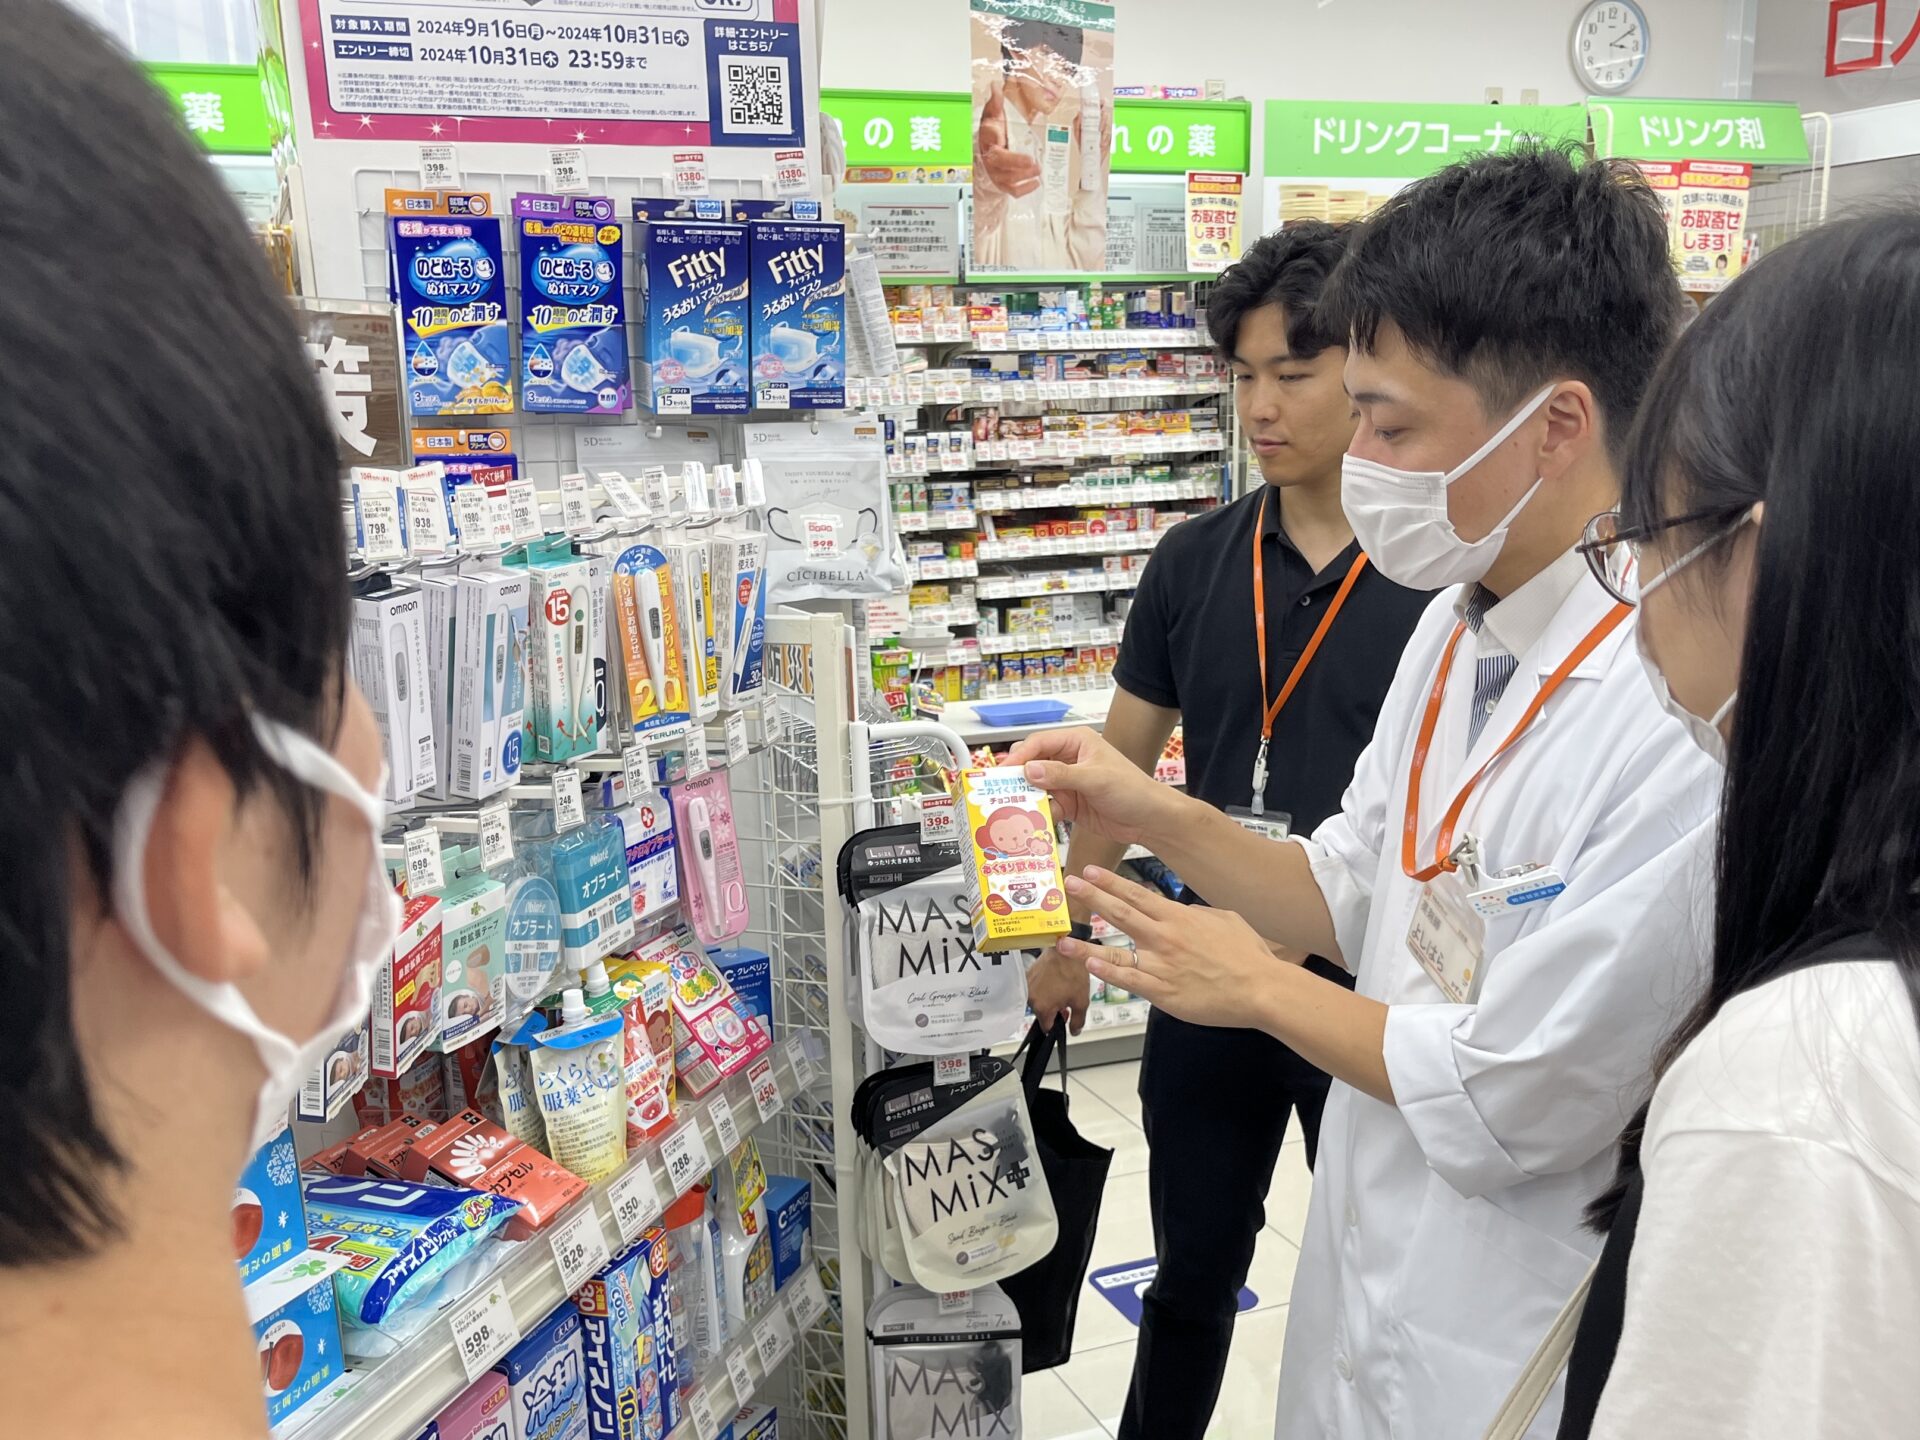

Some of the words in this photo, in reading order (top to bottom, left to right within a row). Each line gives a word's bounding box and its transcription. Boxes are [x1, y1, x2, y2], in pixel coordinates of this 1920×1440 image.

[1597, 11, 1605, 23] 11
[1608, 7, 1617, 19] 12
[1623, 12, 1627, 24] 1
[1588, 23, 1598, 35] 10
[1584, 40, 1591, 51] 9
[1632, 40, 1639, 52] 3
[568, 50, 648, 70] 23:59まで
[1587, 56, 1594, 67] 8
[1595, 67, 1601, 79] 7
[1606, 71, 1612, 81] 6
[1618, 68, 1625, 79] 5
[180, 91, 225, 133] 薬
[1636, 113, 1767, 151] ドリンク剤
[426, 163, 445, 172] 398
[556, 167, 574, 175] 398
[406, 199, 433, 209] 日本製
[533, 201, 559, 211] 日本製
[1191, 209, 1237, 225] お取寄せ
[1681, 209, 1741, 230] お取寄せ
[1683, 232, 1732, 252] します!
[668, 247, 726, 288] Fitty
[768, 244, 824, 284] Fitty
[426, 281, 480, 295] ぬれマスク
[546, 282, 600, 296] ぬれマスク
[427, 436, 453, 447] 日本製
[369, 523, 386, 534] 798
[415, 517, 431, 528] 938
[738, 558, 755, 571] 使える
[786, 571, 865, 582] CICIBELLA
[500, 583, 522, 597] OMRON
[390, 600, 418, 617] OMRON
[547, 595, 569, 623] 15
[648, 728, 685, 741] TERUMO
[629, 769, 641, 780] 318
[685, 777, 714, 791] OMRON
[559, 796, 572, 806] 248
[990, 795, 1027, 805] チョコ風味
[926, 815, 950, 827] 398
[486, 832, 500, 846] 698
[413, 858, 428, 871] 698
[581, 865, 622, 899] オブラート
[878, 894, 973, 936] MAS
[512, 919, 553, 936] オブラート
[736, 962, 769, 975] クレベリン
[940, 1059, 963, 1071] 398
[903, 1127, 996, 1187] MAS
[672, 1153, 690, 1176] 288
[489, 1160, 535, 1196] カプセル
[619, 1197, 638, 1220] 350
[382, 1231, 443, 1286] アイスノン
[563, 1244, 584, 1270] 828
[611, 1287, 627, 1329] COOL
[557, 1318, 575, 1338] 大人用
[465, 1325, 490, 1355] 598
[584, 1318, 615, 1436] アイスノン
[890, 1358, 986, 1398] MAS
